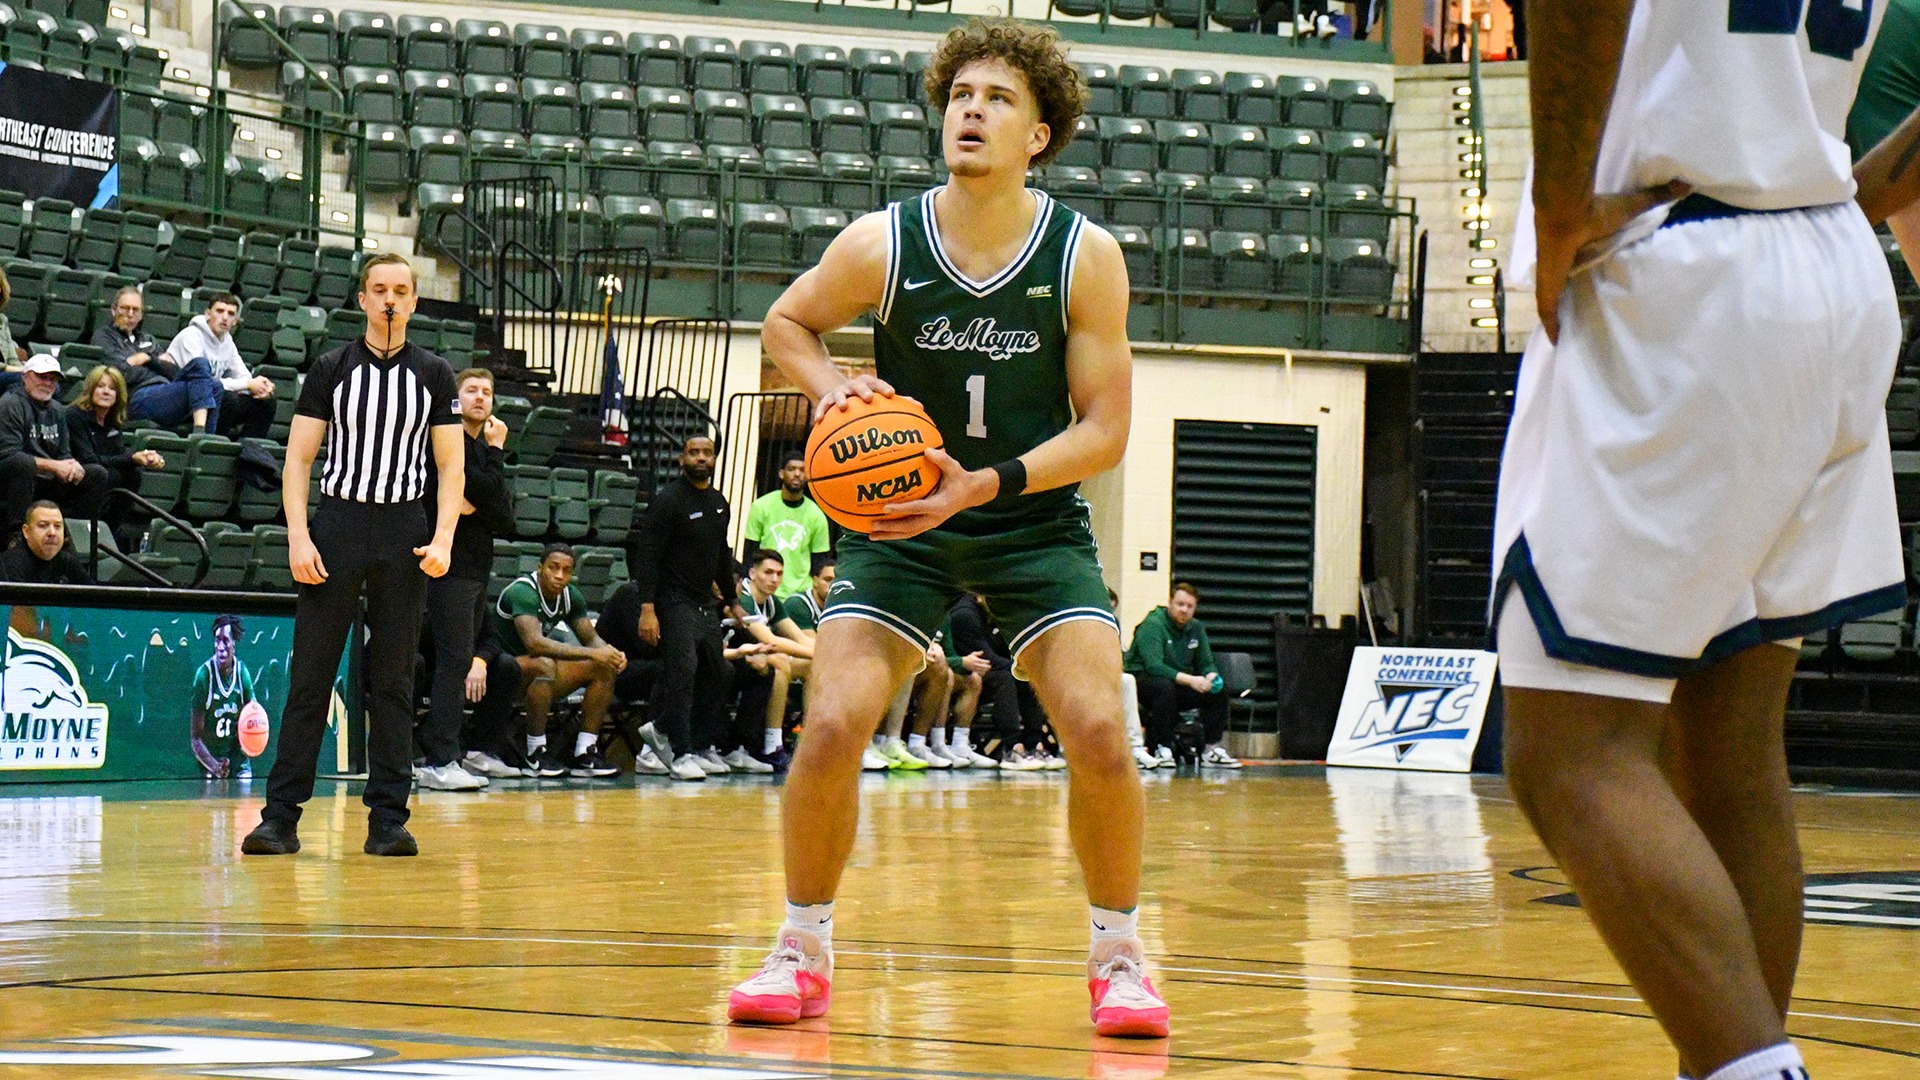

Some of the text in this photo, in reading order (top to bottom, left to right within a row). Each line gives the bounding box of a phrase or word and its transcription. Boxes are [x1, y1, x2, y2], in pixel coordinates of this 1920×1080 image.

[44, 126, 115, 160] CONFERENCE
[1026, 285, 1052, 296] NEC
[966, 375, 986, 438] 1
[829, 427, 924, 464] Wilson
[857, 469, 922, 503] NCAA
[1378, 668, 1472, 683] CONFERENCE
[1380, 655, 1475, 668] NORTHEAST
[1, 713, 101, 742] MOYNE
[1350, 682, 1479, 739] NEC
